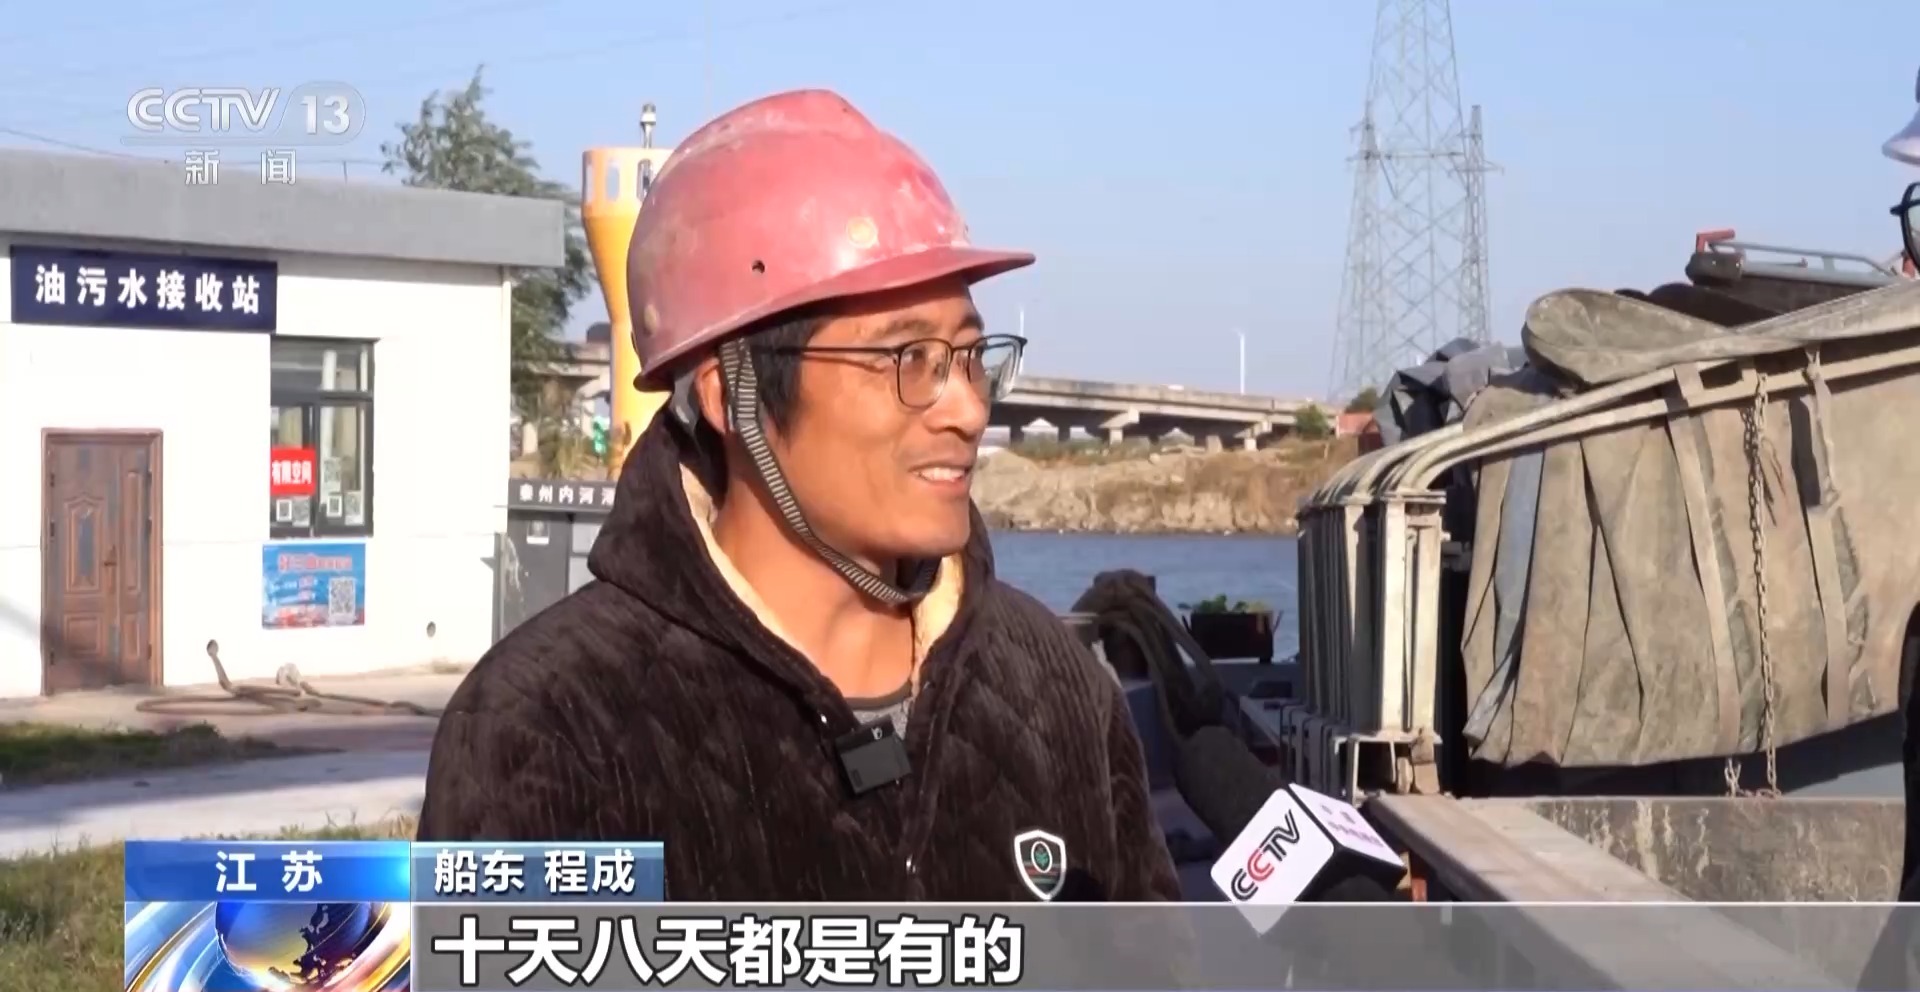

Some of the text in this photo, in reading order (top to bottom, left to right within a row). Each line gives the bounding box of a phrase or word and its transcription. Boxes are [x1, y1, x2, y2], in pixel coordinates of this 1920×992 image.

[34, 263, 260, 315] 油污水接收站
[1231, 809, 1300, 901] CCTV
